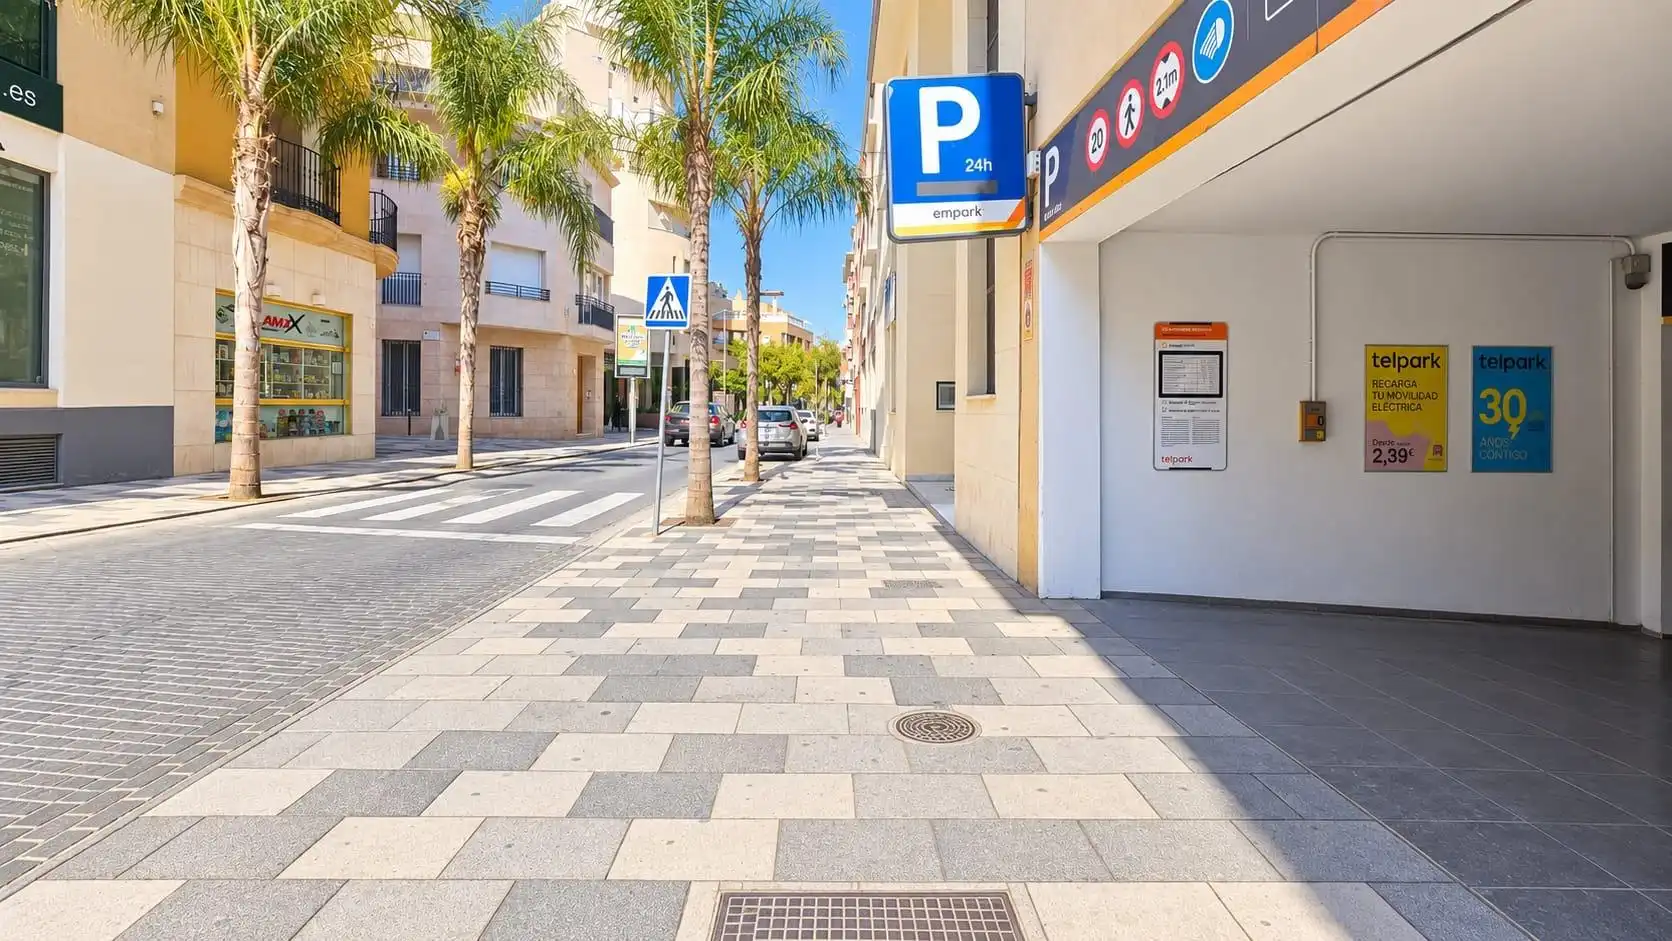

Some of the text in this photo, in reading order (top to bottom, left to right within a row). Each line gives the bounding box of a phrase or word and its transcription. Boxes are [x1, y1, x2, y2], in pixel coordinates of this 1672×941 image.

[1156, 68, 1178, 97] 2.1m
[3, 84, 36, 107] .es
[919, 86, 981, 175] P
[1091, 127, 1104, 154] 20
[965, 158, 993, 172] 24h
[1045, 146, 1060, 208] P
[933, 206, 983, 221] empark
[1372, 352, 1441, 373] telpark
[1479, 353, 1548, 373] telpark
[1371, 379, 1418, 389] RECARGA
[1372, 391, 1439, 401] TU MOVILIDAD
[1479, 387, 1527, 426] 30
[1161, 455, 1193, 465] telpark
[1480, 449, 1529, 460] CONTIGO
